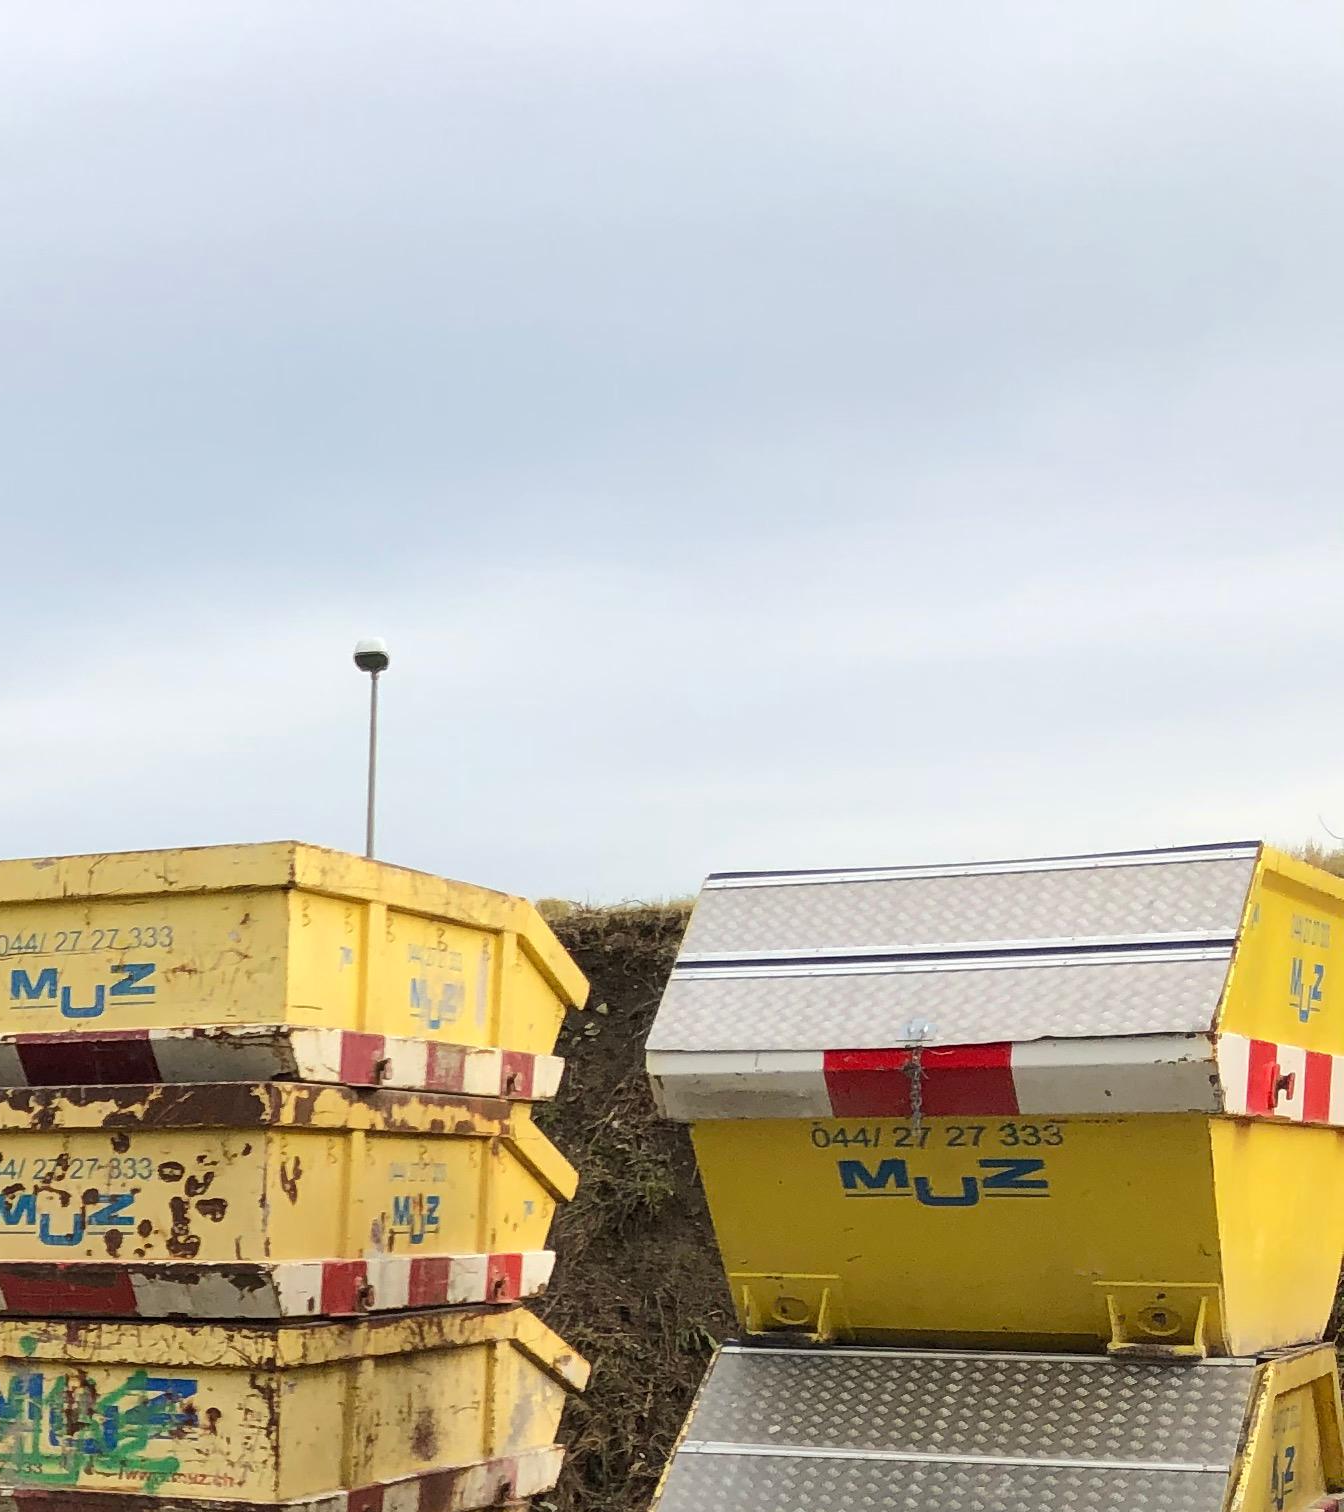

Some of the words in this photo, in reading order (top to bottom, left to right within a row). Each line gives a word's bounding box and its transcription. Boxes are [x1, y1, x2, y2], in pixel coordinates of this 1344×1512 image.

[55, 931, 81, 952] 27
[91, 928, 118, 951] 27
[127, 925, 174, 949] 333
[10, 962, 156, 1018] MUZ
[812, 1124, 880, 1148] 044/
[892, 1126, 931, 1149] 27
[945, 1125, 987, 1148] 27
[1000, 1123, 1064, 1147] 333
[32, 1157, 64, 1181] 27
[69, 1157, 99, 1181] 27
[108, 1156, 153, 1181] 333
[837, 1157, 1050, 1207] MUZ
